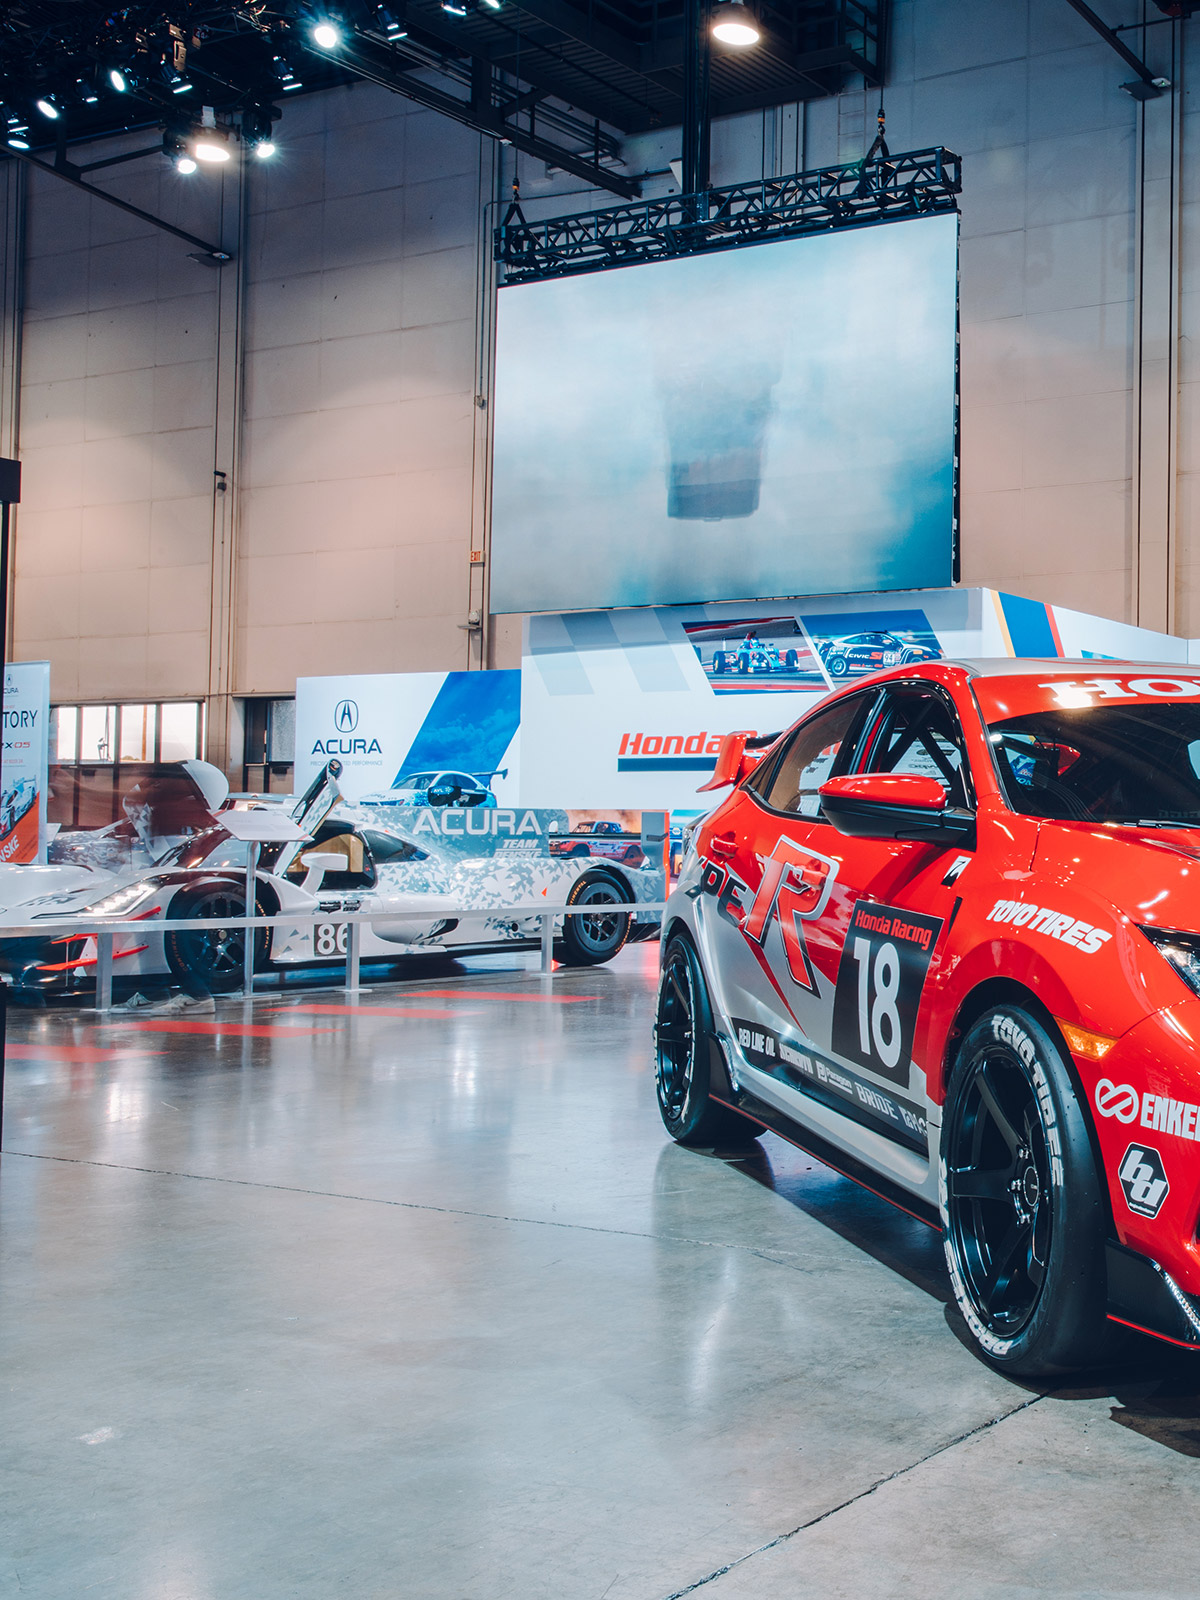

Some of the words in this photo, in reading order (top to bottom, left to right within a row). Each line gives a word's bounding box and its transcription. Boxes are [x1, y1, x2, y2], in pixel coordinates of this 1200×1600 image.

[311, 738, 383, 755] ACURA
[618, 731, 728, 756] Honda
[412, 809, 543, 836] ACURA
[502, 838, 540, 849] TEAM
[855, 909, 891, 936] Honda
[890, 917, 933, 951] Racing
[986, 899, 1039, 927] TOYO
[1027, 907, 1113, 954] TIRES
[853, 936, 902, 1068] 18
[738, 1027, 751, 1048] RED
[751, 1032, 765, 1054] LINE
[765, 1036, 776, 1058] OIL
[855, 1081, 900, 1121] BRIDE
